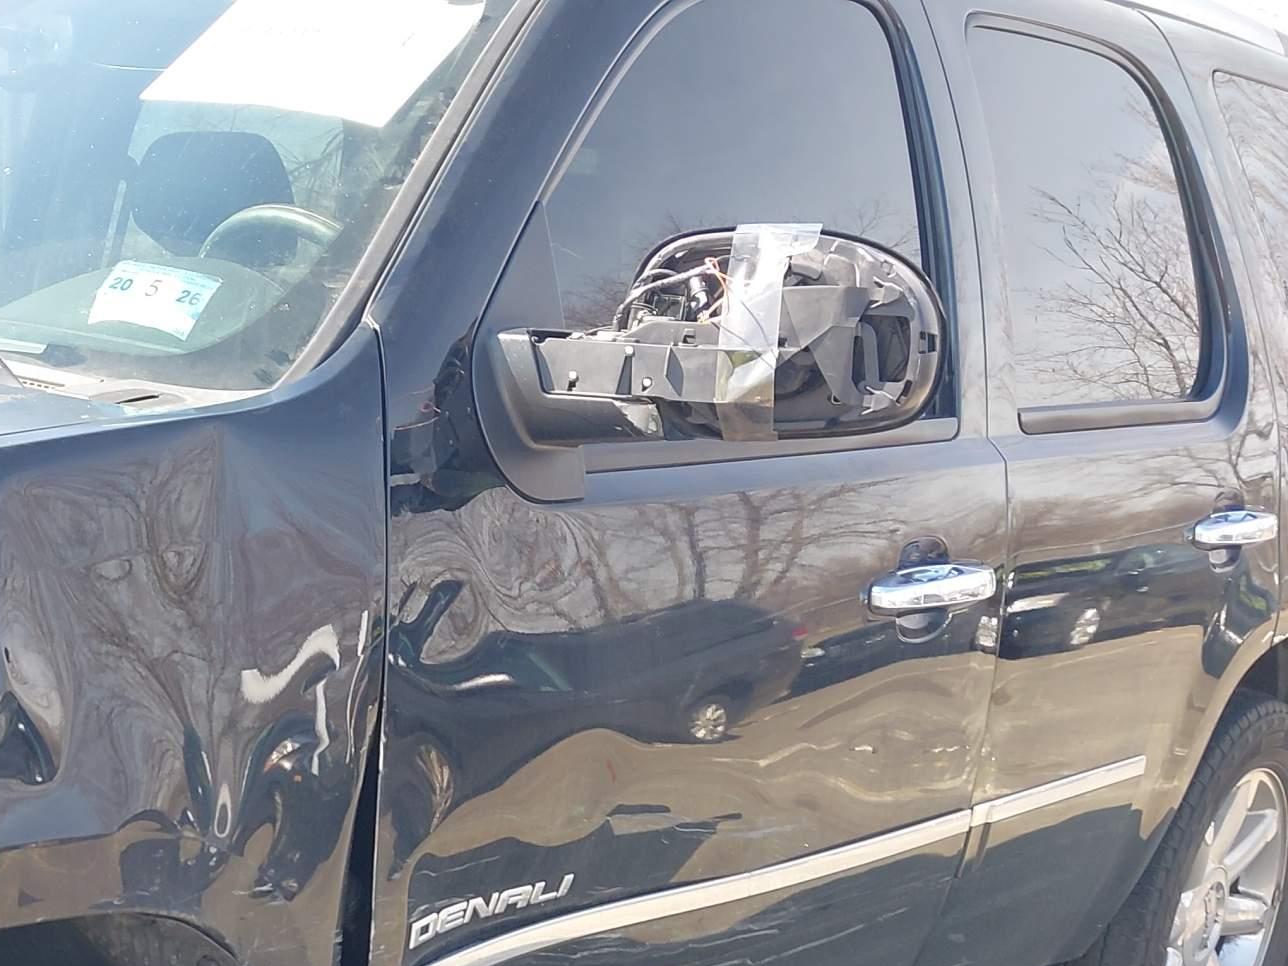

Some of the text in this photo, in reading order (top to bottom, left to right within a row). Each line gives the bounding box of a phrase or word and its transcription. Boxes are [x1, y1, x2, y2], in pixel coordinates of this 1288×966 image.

[109, 277, 134, 291] 20
[144, 279, 163, 297] 5
[175, 290, 201, 306] 26
[409, 873, 575, 949] DENALI
